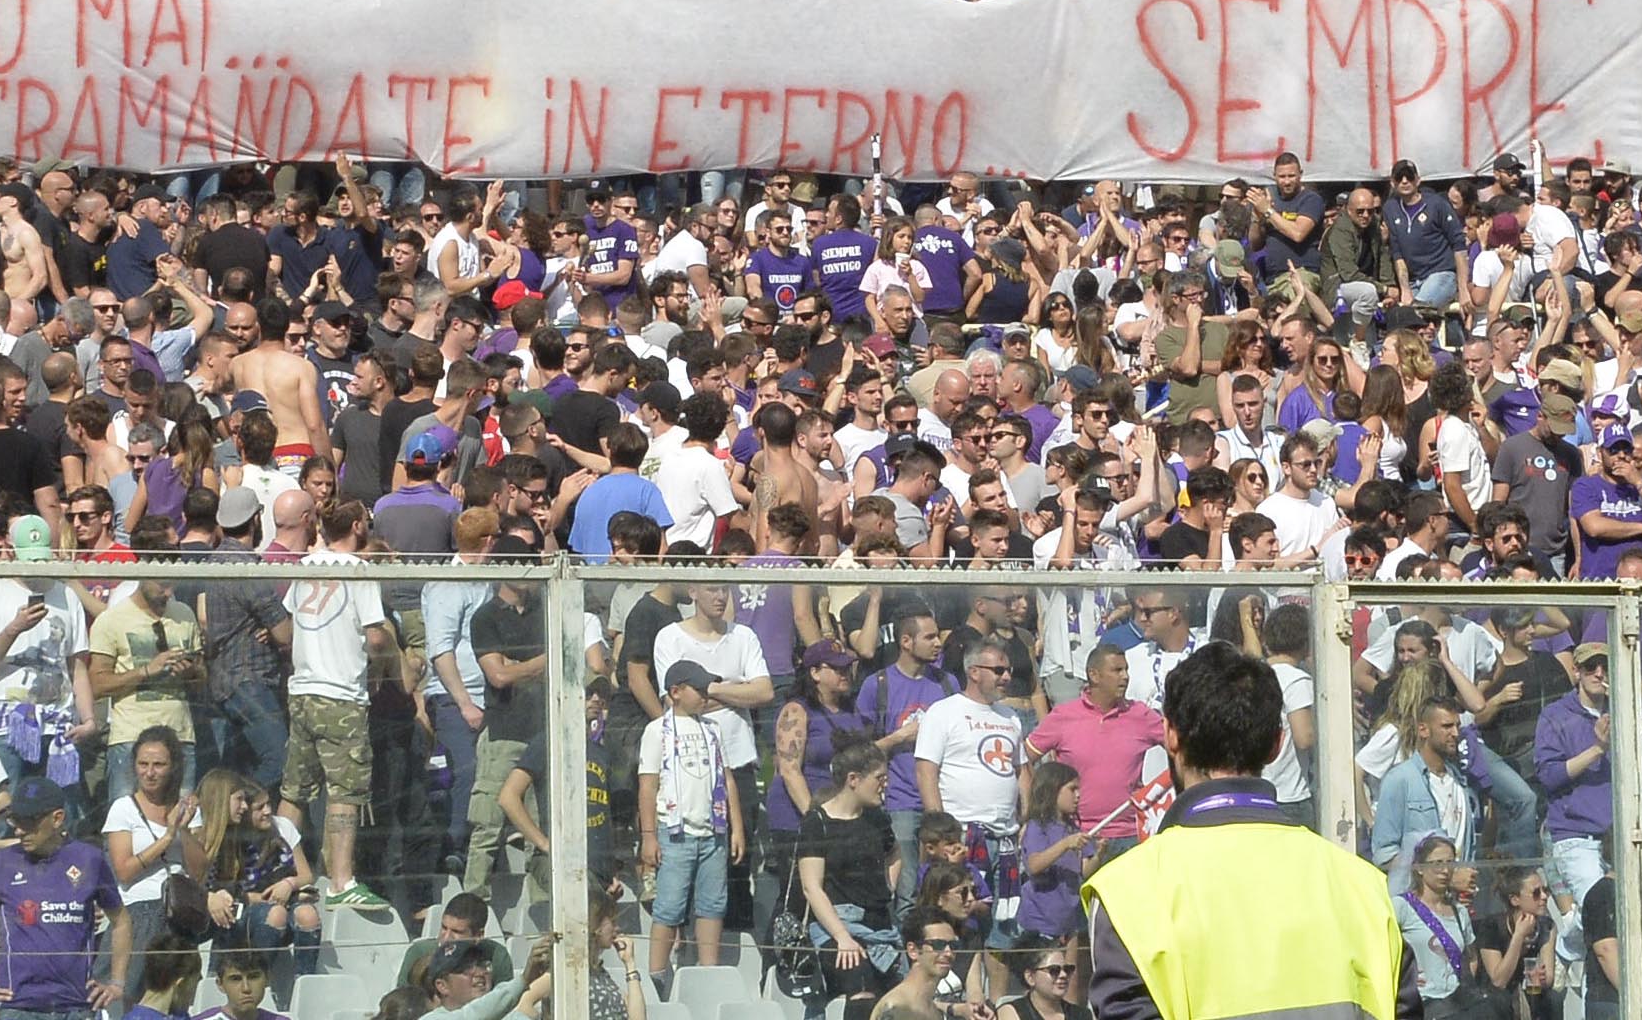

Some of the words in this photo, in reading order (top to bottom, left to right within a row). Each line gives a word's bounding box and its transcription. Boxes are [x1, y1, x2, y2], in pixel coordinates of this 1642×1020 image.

[821, 246, 862, 260] SIEMPRE
[822, 261, 862, 274] CONTIGO
[40, 901, 67, 913] Save
